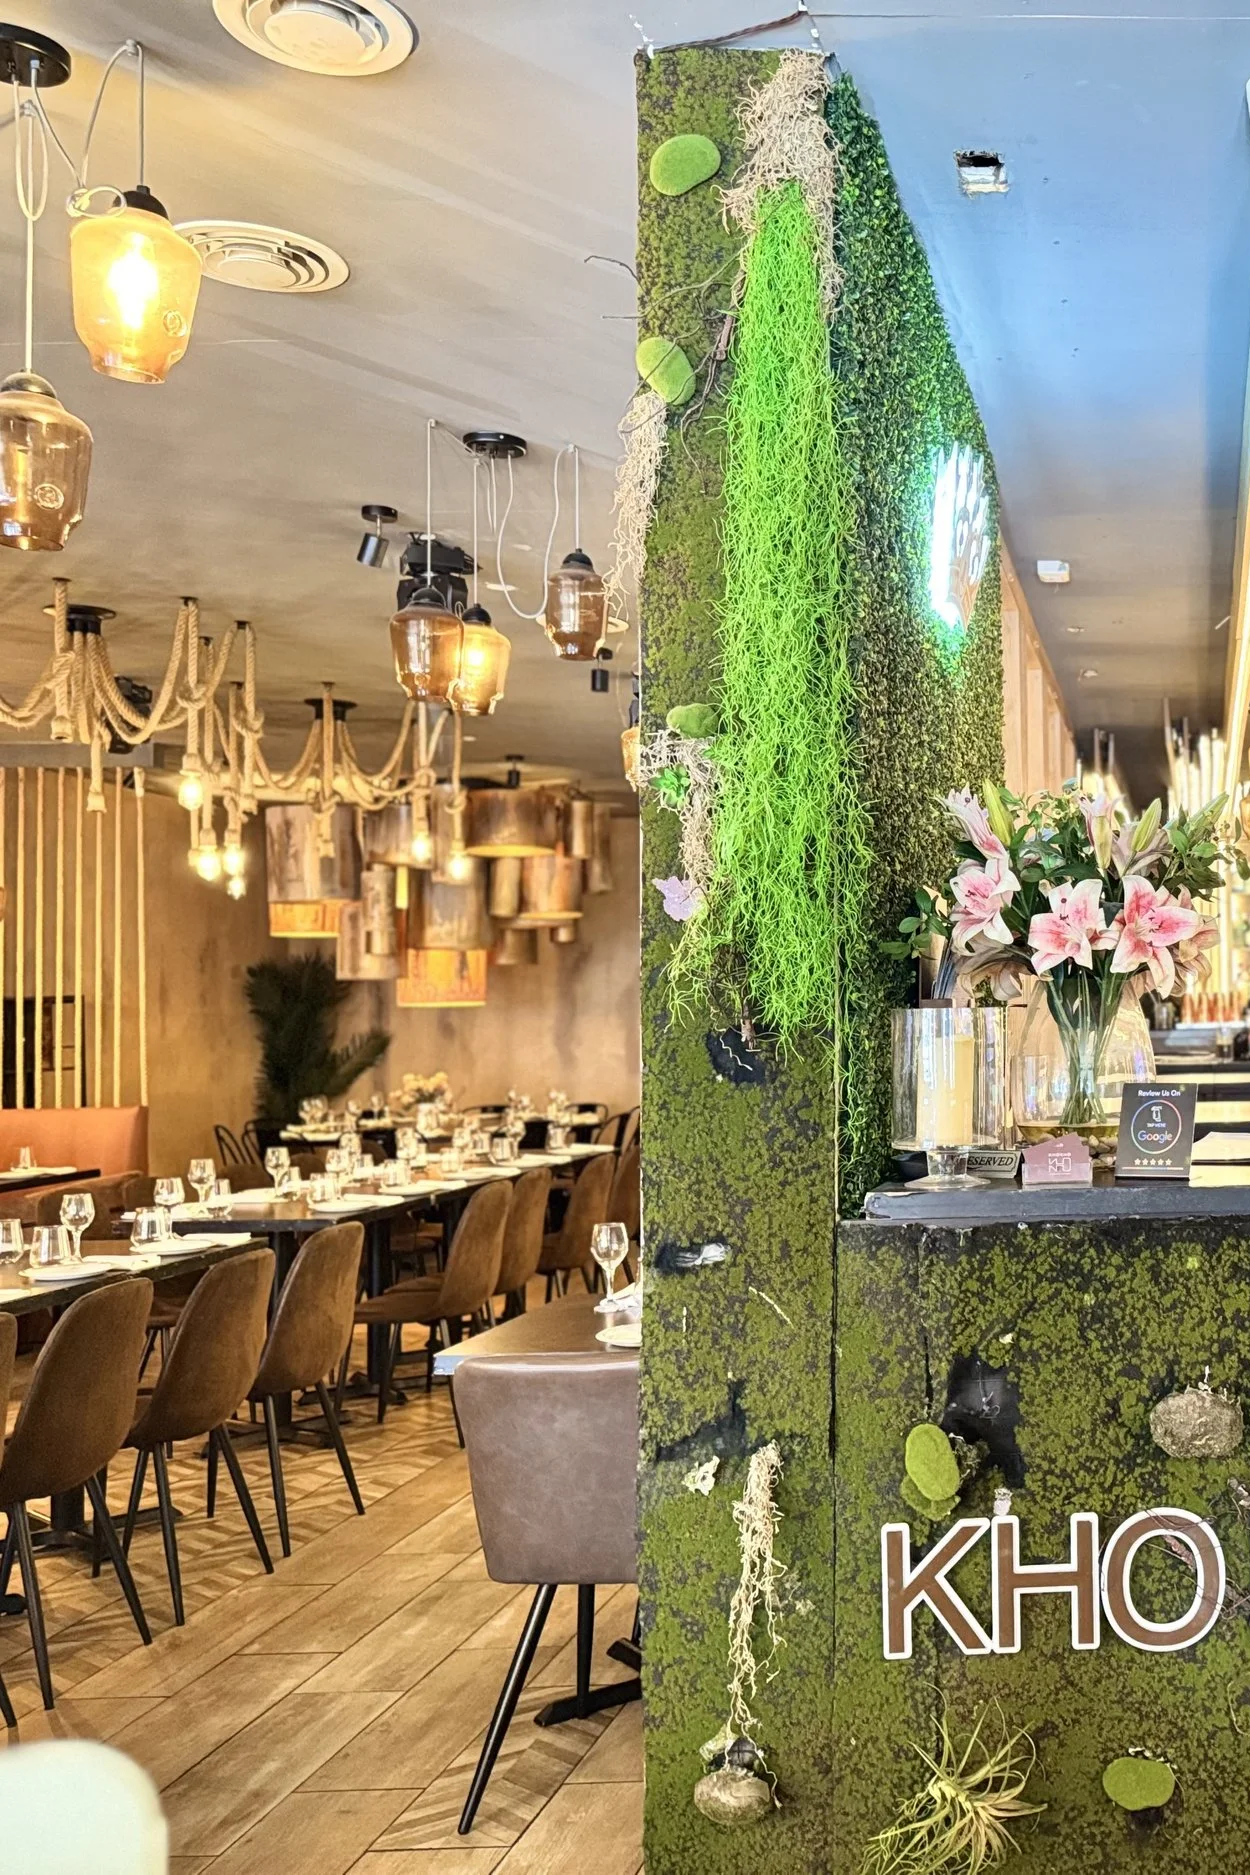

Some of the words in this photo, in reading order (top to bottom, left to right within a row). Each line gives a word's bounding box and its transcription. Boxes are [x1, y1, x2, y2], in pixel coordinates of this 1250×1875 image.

[1138, 1130, 1173, 1144] Google
[966, 1156, 1014, 1167] ESERVED
[882, 1506, 1226, 1660] KHO
